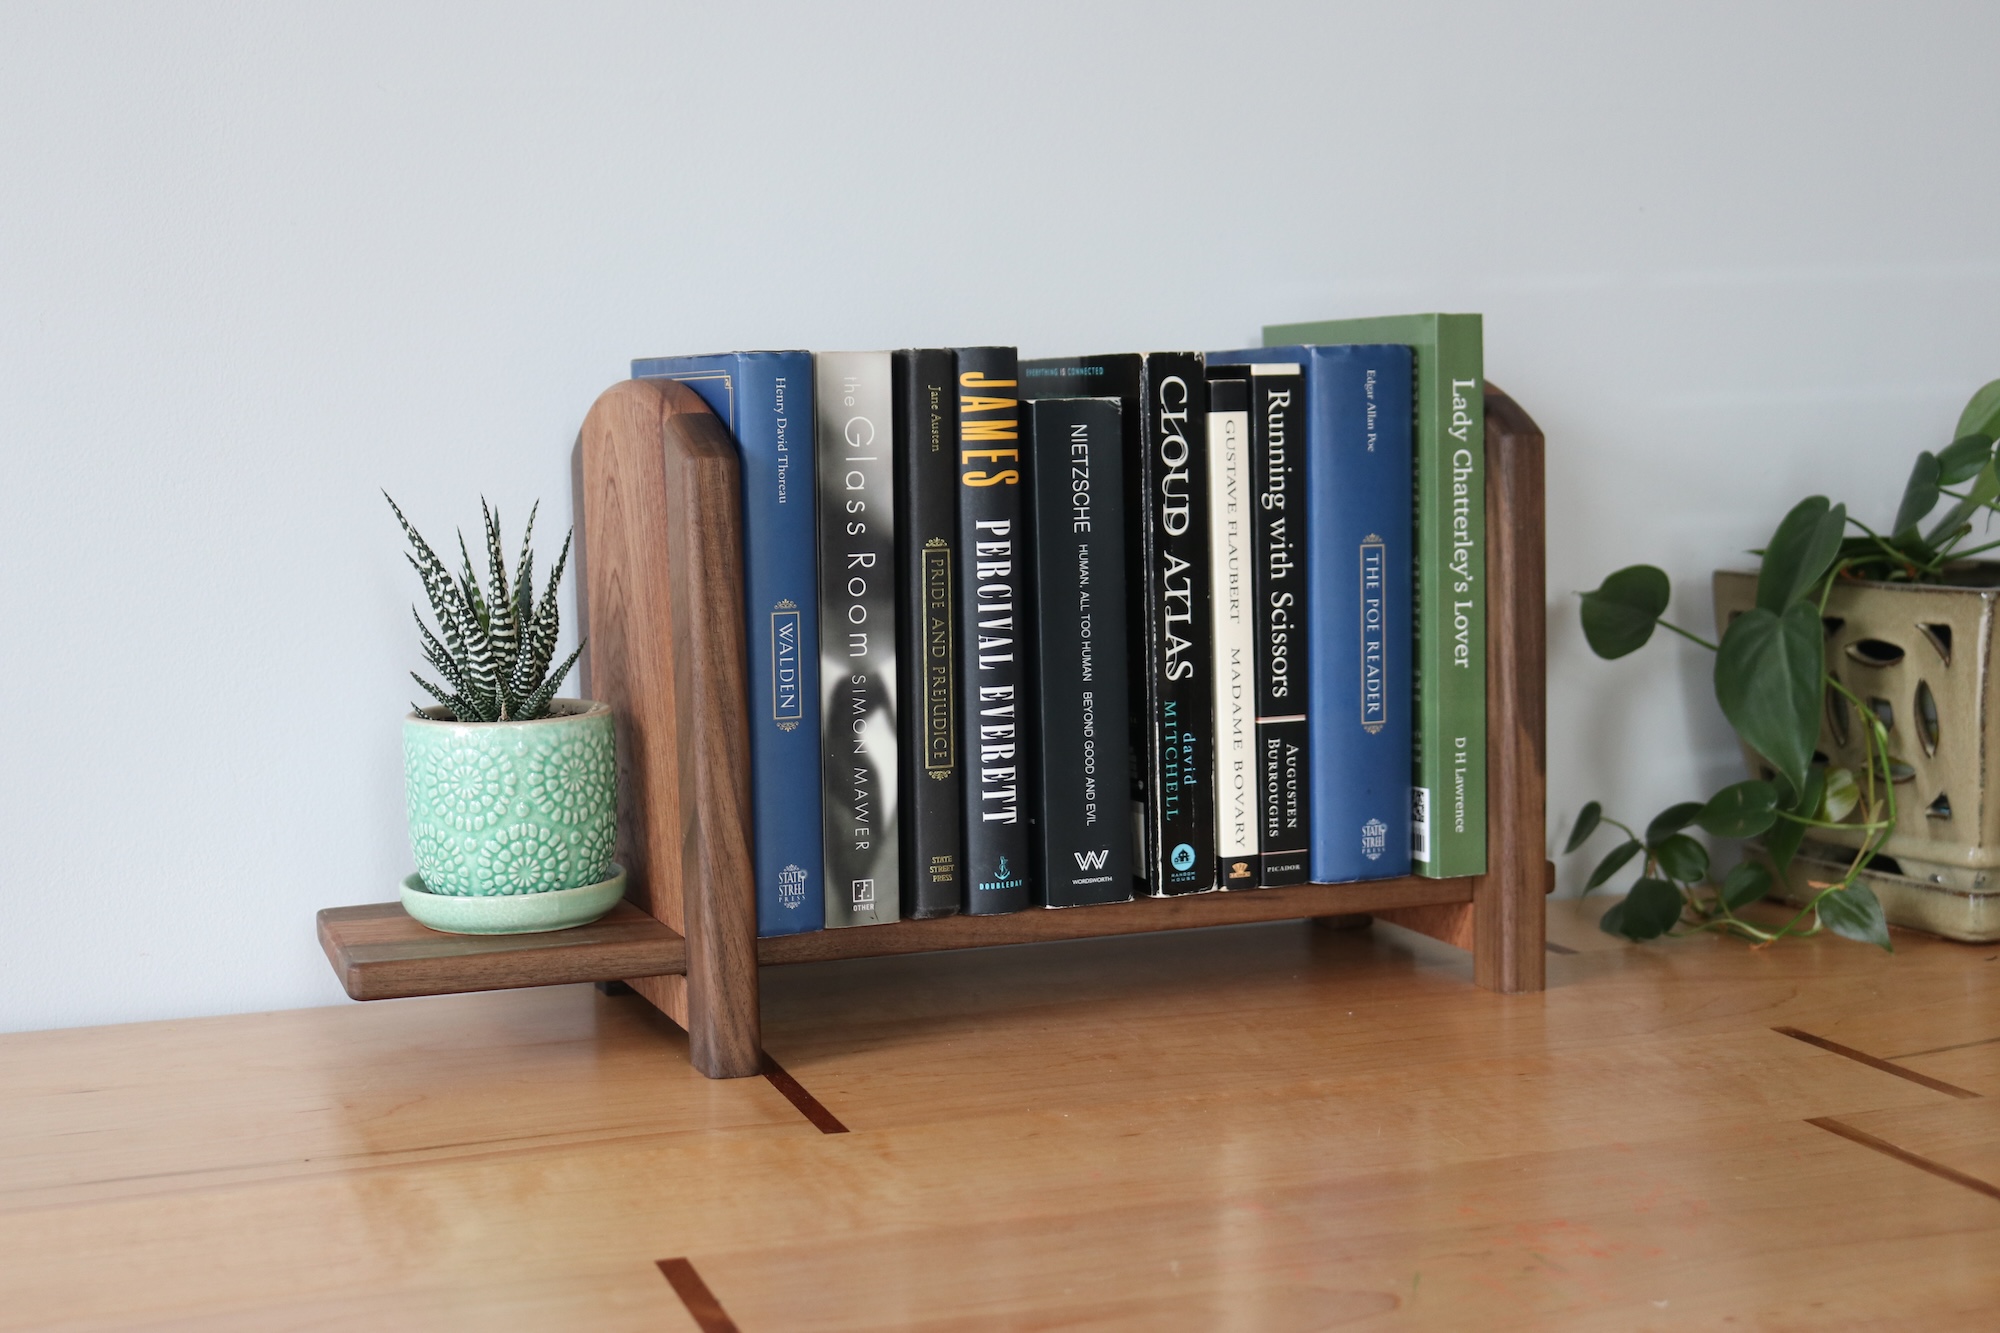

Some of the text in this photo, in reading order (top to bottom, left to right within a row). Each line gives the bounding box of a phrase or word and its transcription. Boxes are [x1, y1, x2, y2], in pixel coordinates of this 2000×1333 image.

[1067, 366, 1104, 376] CONNECTED
[774, 377, 788, 503] Henry David Thoreau
[928, 385, 941, 452] Jane Austen
[1364, 369, 1377, 452] Edgar Allan Poe
[1071, 424, 1090, 533] NIETZSCHE
[1159, 375, 1193, 681] CLOUD ATLAS
[1261, 389, 1294, 698] Running with Scissors
[1448, 378, 1475, 668] Lady Chatterley's Lover
[844, 377, 877, 850] the Glass Room SIMON MAWER
[960, 371, 1019, 825] JAMES PERCIVAL EVERETT
[1080, 592, 1090, 611] ALL
[1081, 614, 1091, 638] TOO
[778, 622, 794, 709] WALDEN
[931, 559, 947, 760] PRIDE AND PREJUDICE
[1082, 640, 1092, 681] HUMAN
[1225, 420, 1246, 847] GUSTAVE FLAUBERT MADAME BOVARY
[1366, 553, 1380, 713] THE POE READER
[1083, 692, 1093, 737] BEYOND
[1084, 741, 1094, 774] GOOD
[1085, 777, 1095, 800] AND
[1164, 700, 1179, 821] MITCHELL
[1182, 732, 1197, 786] david
[1267, 738, 1280, 837] BURROUGHS
[1286, 744, 1299, 828] AUGUSTEN
[1455, 737, 1466, 833] D H Lawrence
[1086, 802, 1096, 826] EVIL
[778, 883, 805, 896] STREET
[930, 865, 954, 873] STREET
[932, 855, 952, 863] STATE
[933, 874, 952, 882] PRESS
[979, 880, 1023, 890] DOUBLEDAY
[1072, 875, 1113, 884] WORDSWORTH
[853, 903, 874, 911] OTHER
